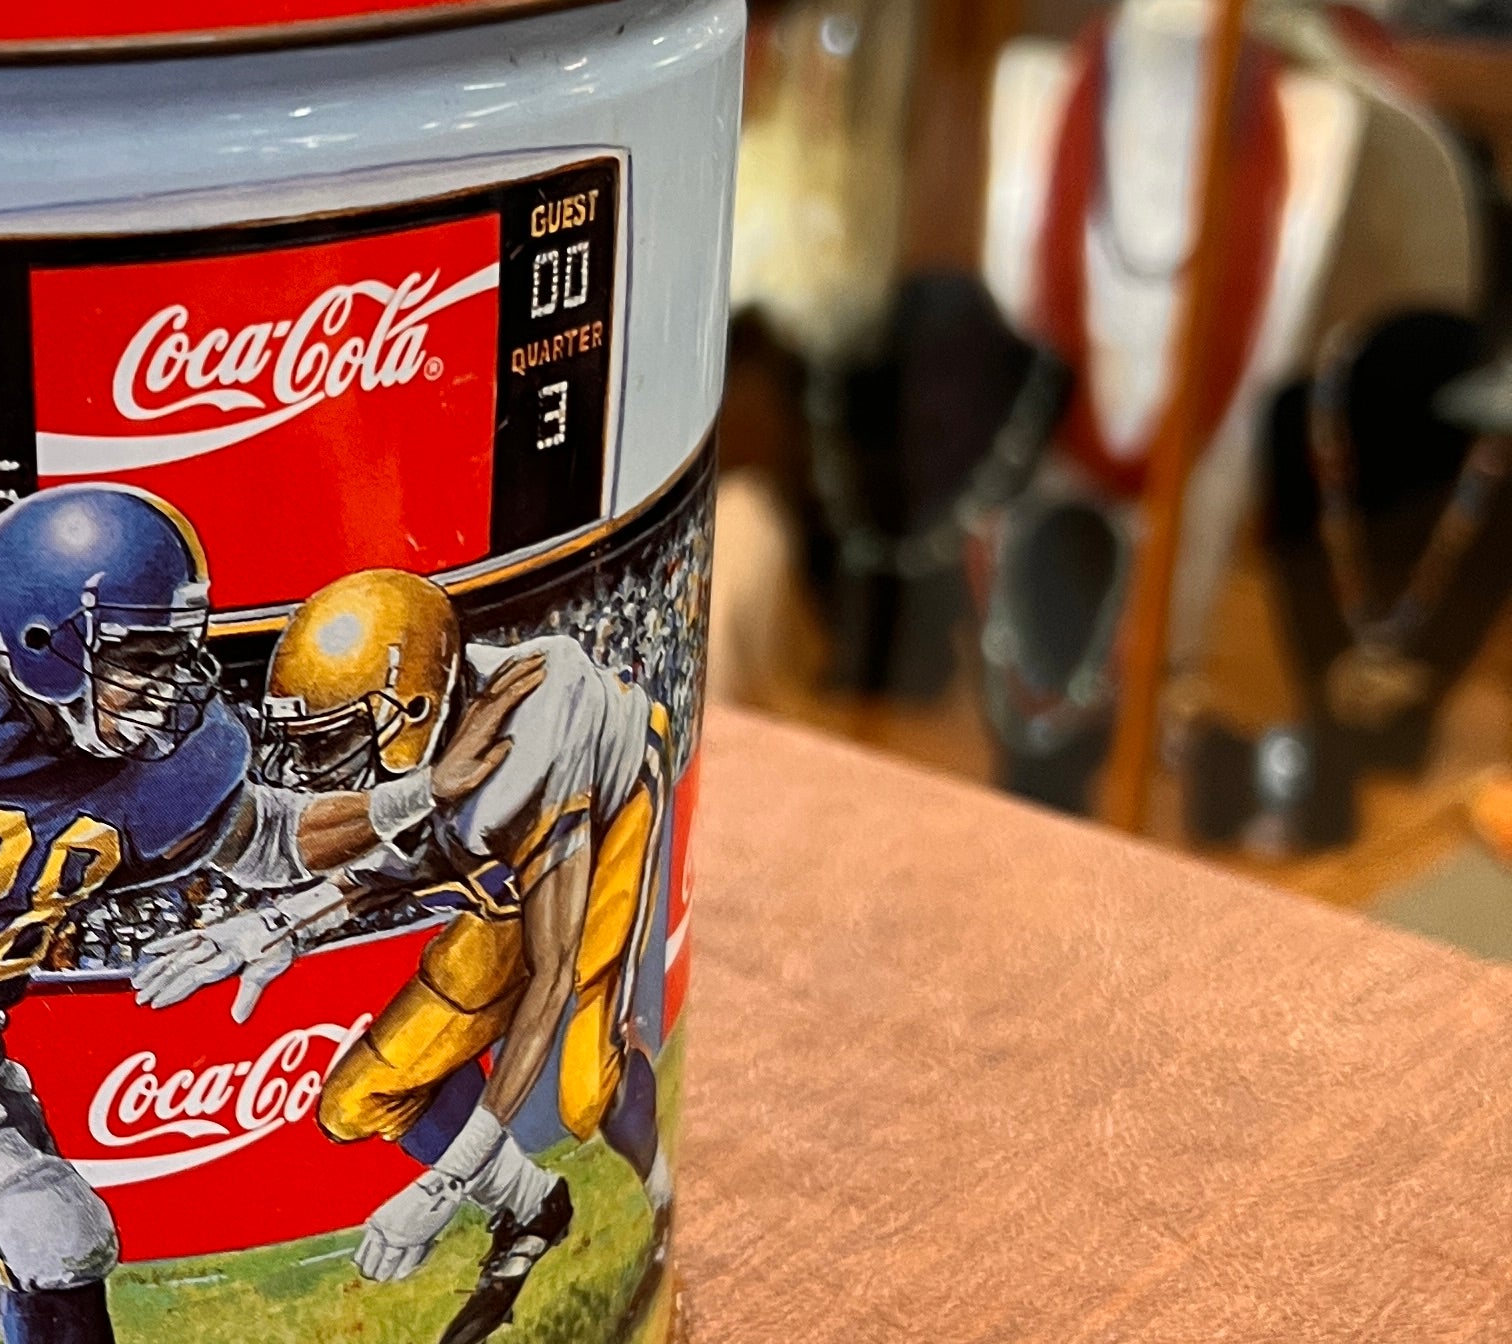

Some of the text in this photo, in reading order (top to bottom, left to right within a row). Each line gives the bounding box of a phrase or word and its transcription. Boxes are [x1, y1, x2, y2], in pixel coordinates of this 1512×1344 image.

[531, 189, 599, 238] GUEST
[531, 241, 589, 319] 00
[511, 320, 604, 376] QUARTER
[536, 380, 568, 450] 3
